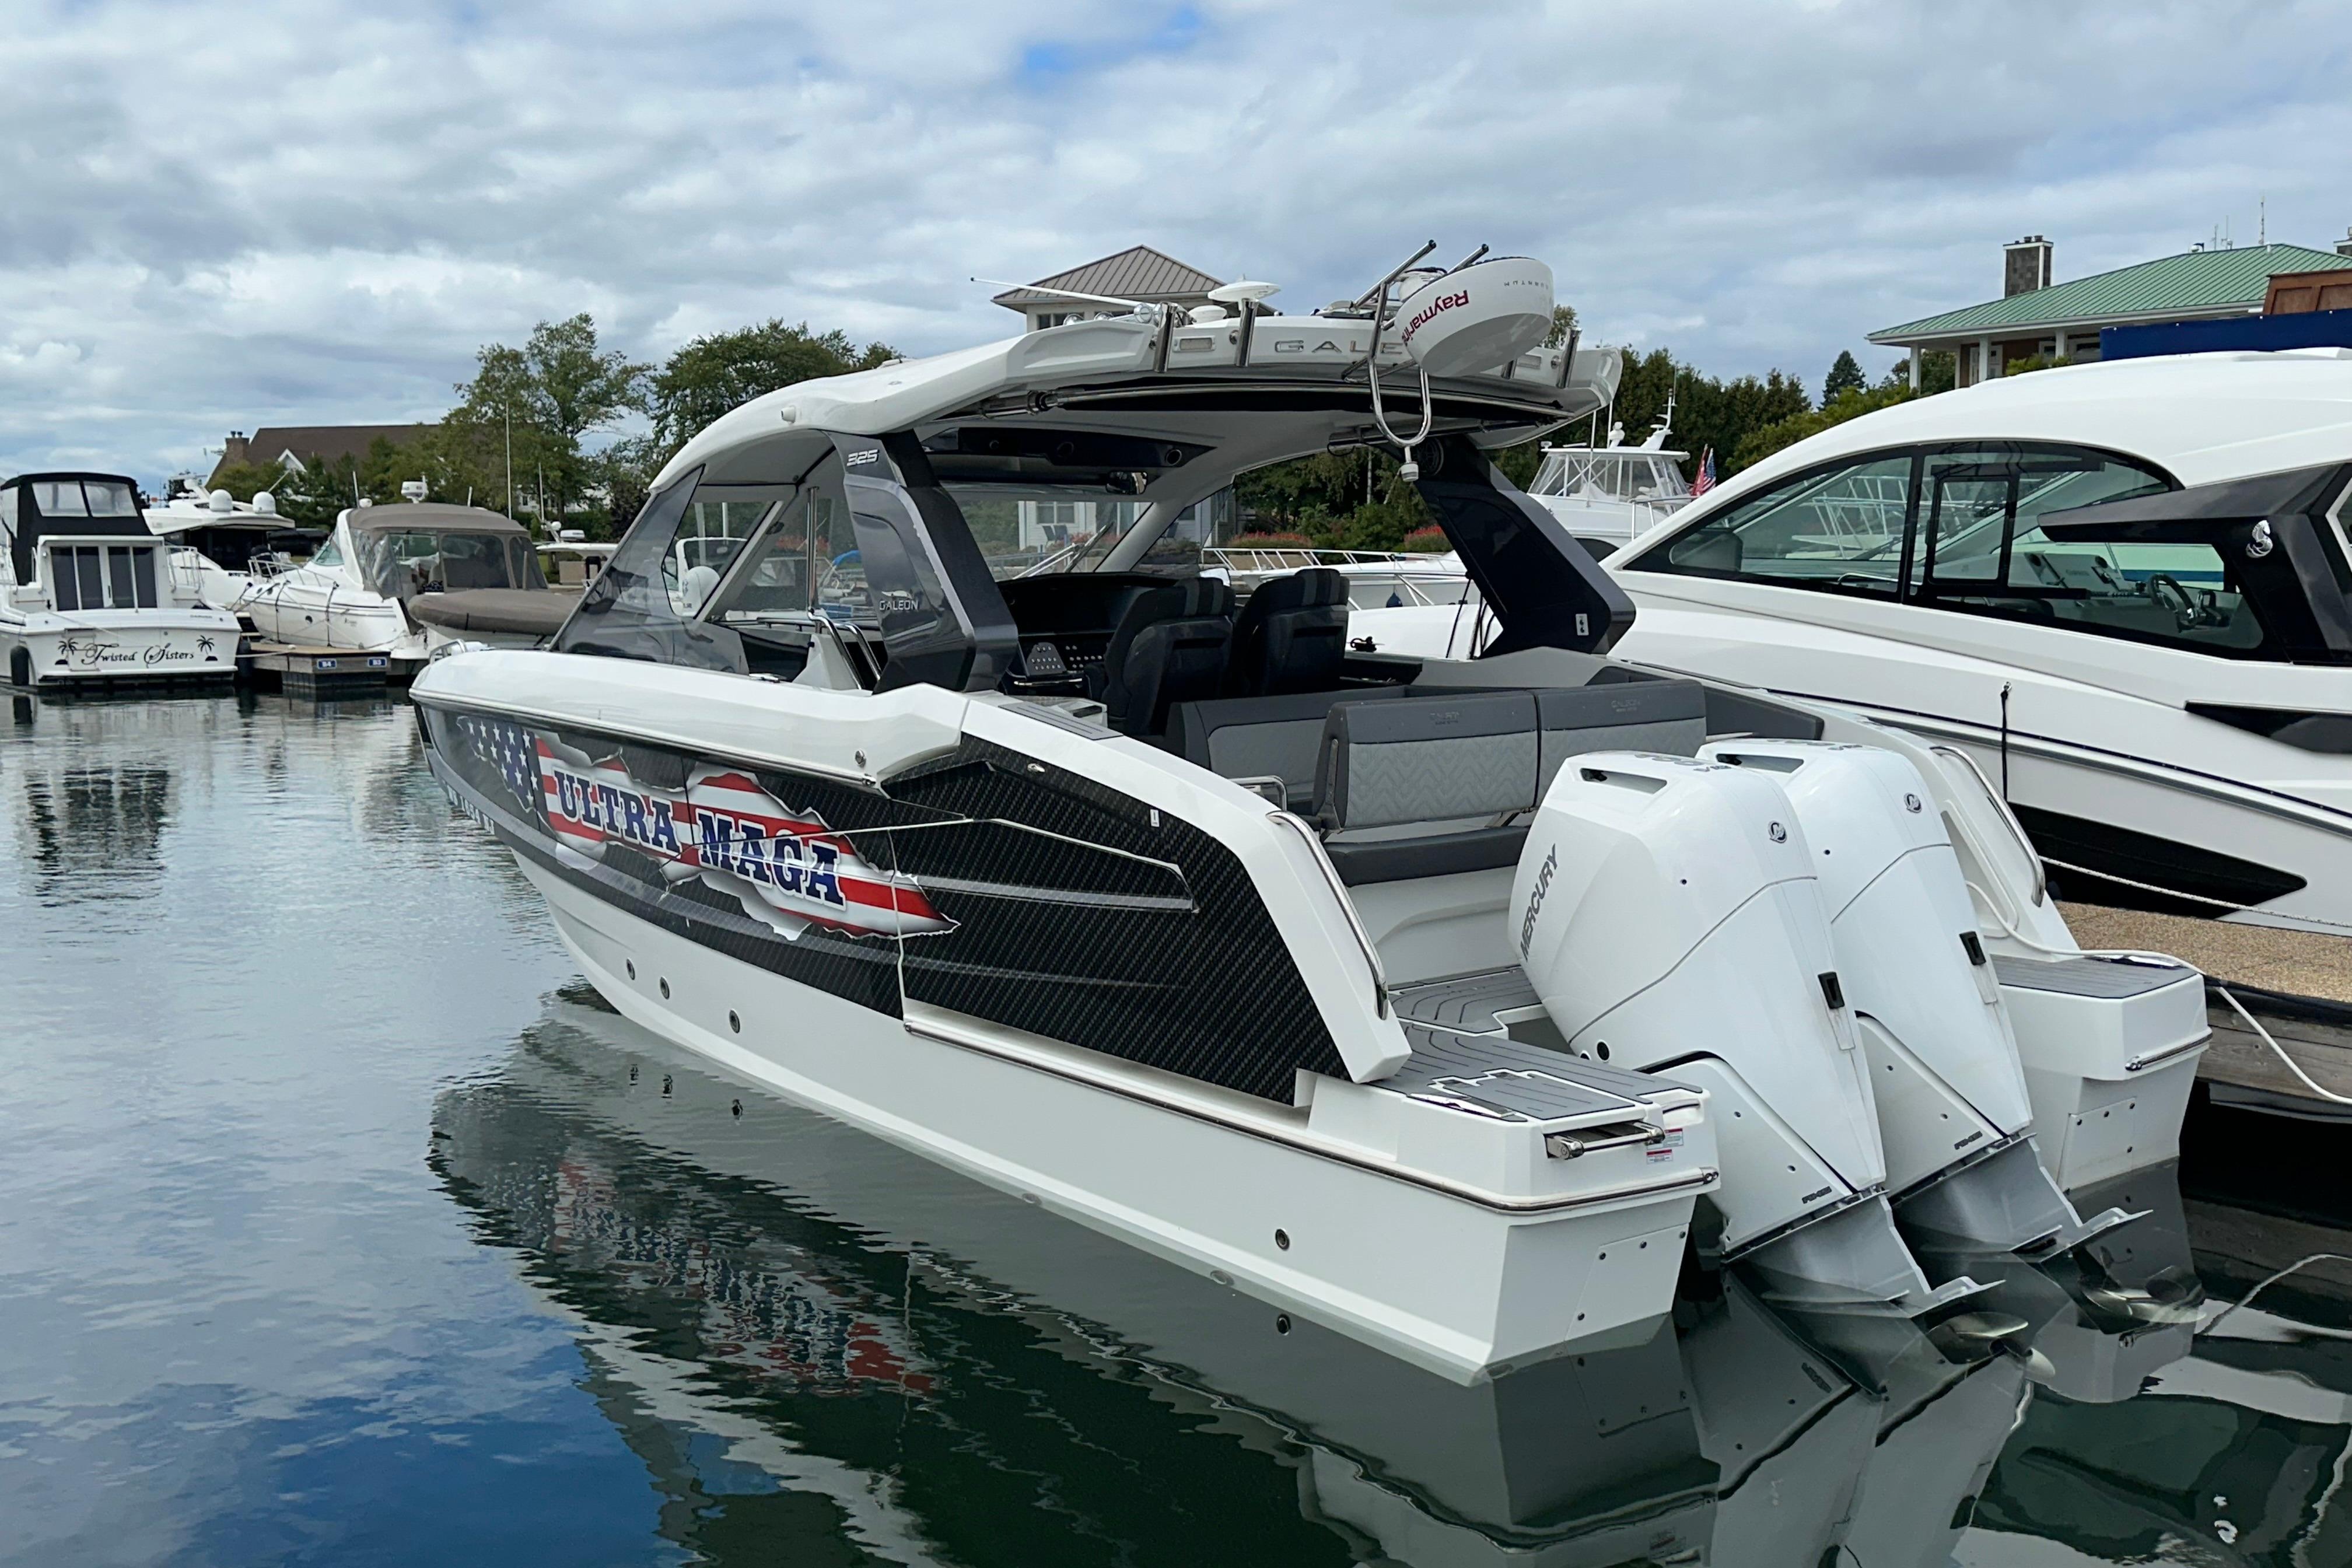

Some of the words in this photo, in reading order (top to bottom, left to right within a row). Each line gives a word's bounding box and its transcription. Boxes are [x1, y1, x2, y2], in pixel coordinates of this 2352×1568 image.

[1275, 340, 1403, 354] GALE
[846, 449, 879, 466] 325
[879, 600, 919, 611] GALEON
[81, 643, 138, 665] Twisted
[144, 642, 194, 668] Sisters
[553, 768, 681, 858] ULTRA
[698, 810, 845, 909] MAGA
[1520, 843, 1558, 963] MERCURY
